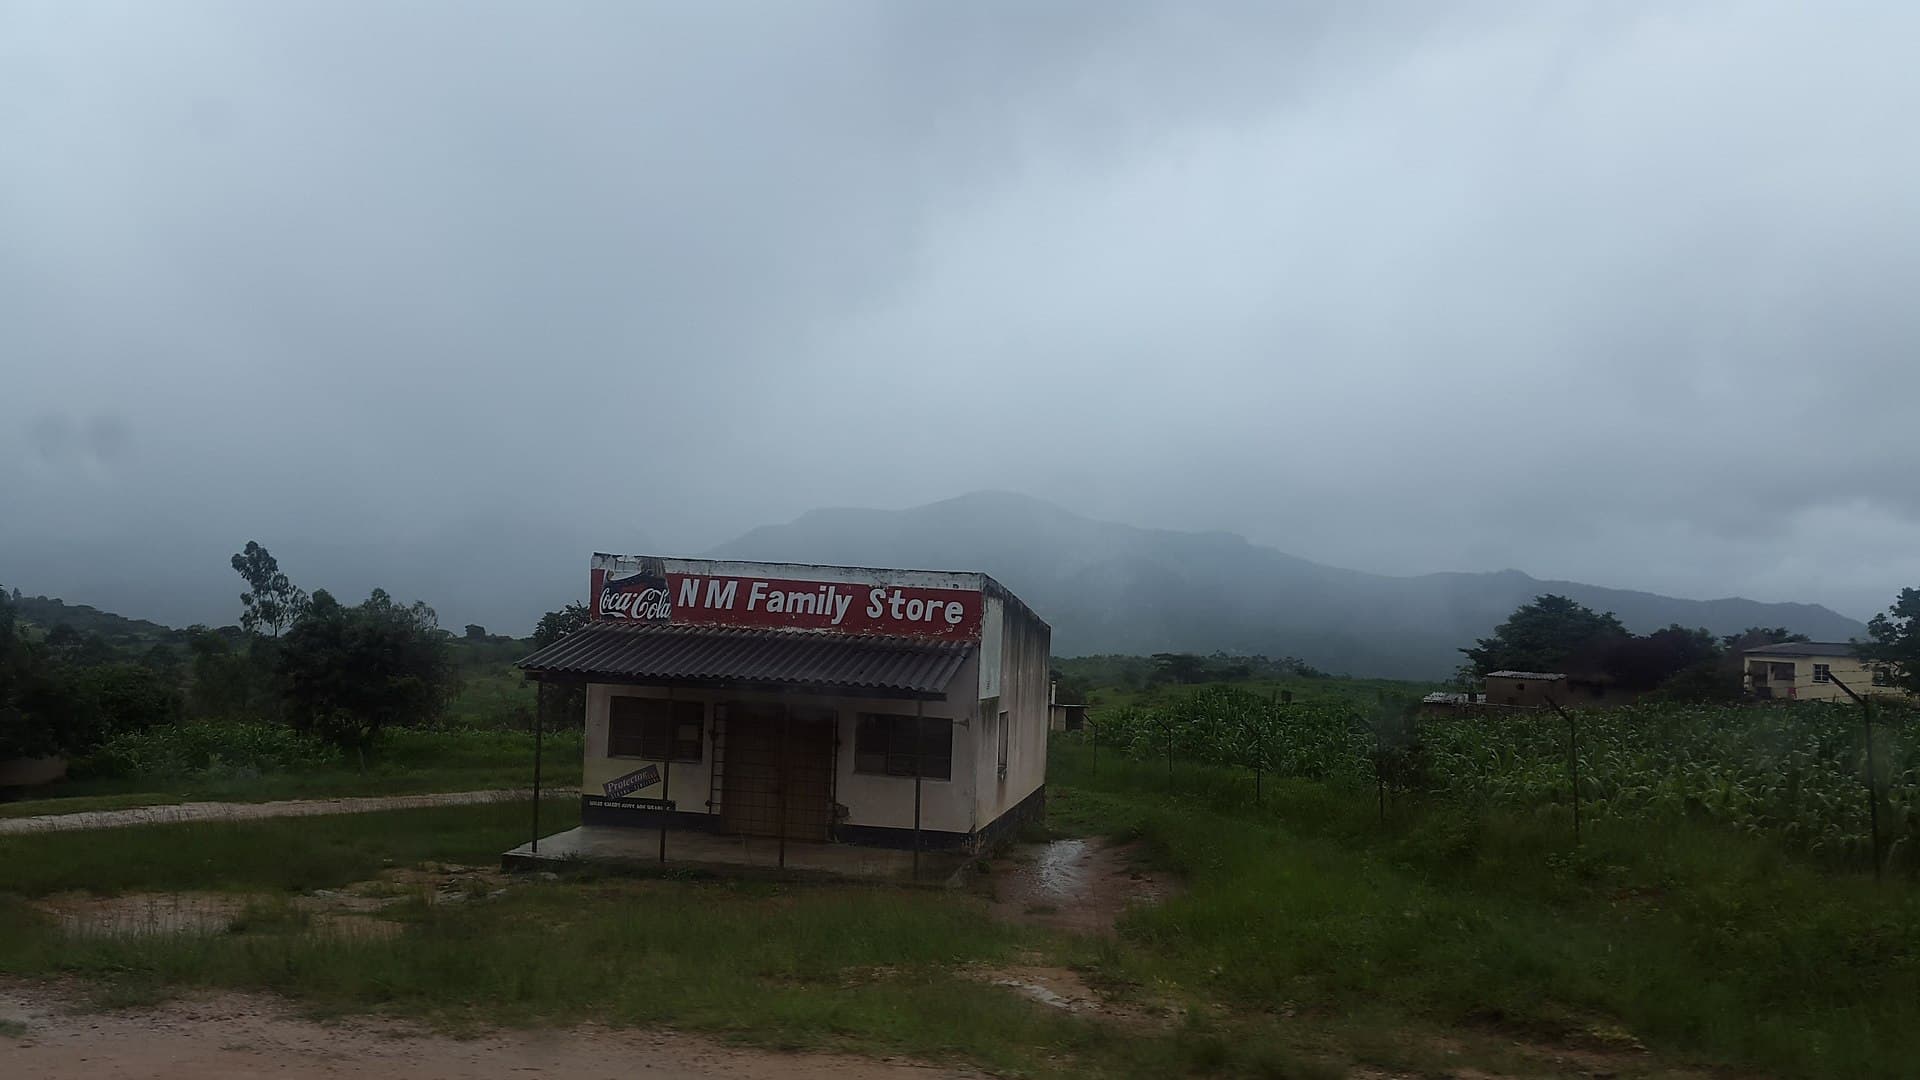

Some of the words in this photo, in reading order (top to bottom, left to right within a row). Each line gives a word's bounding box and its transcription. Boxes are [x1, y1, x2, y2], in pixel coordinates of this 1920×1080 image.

[599, 587, 671, 620] Coca-Cola
[678, 578, 700, 607] N
[704, 580, 738, 609] M
[748, 582, 853, 625] Family
[867, 588, 965, 625] Store
